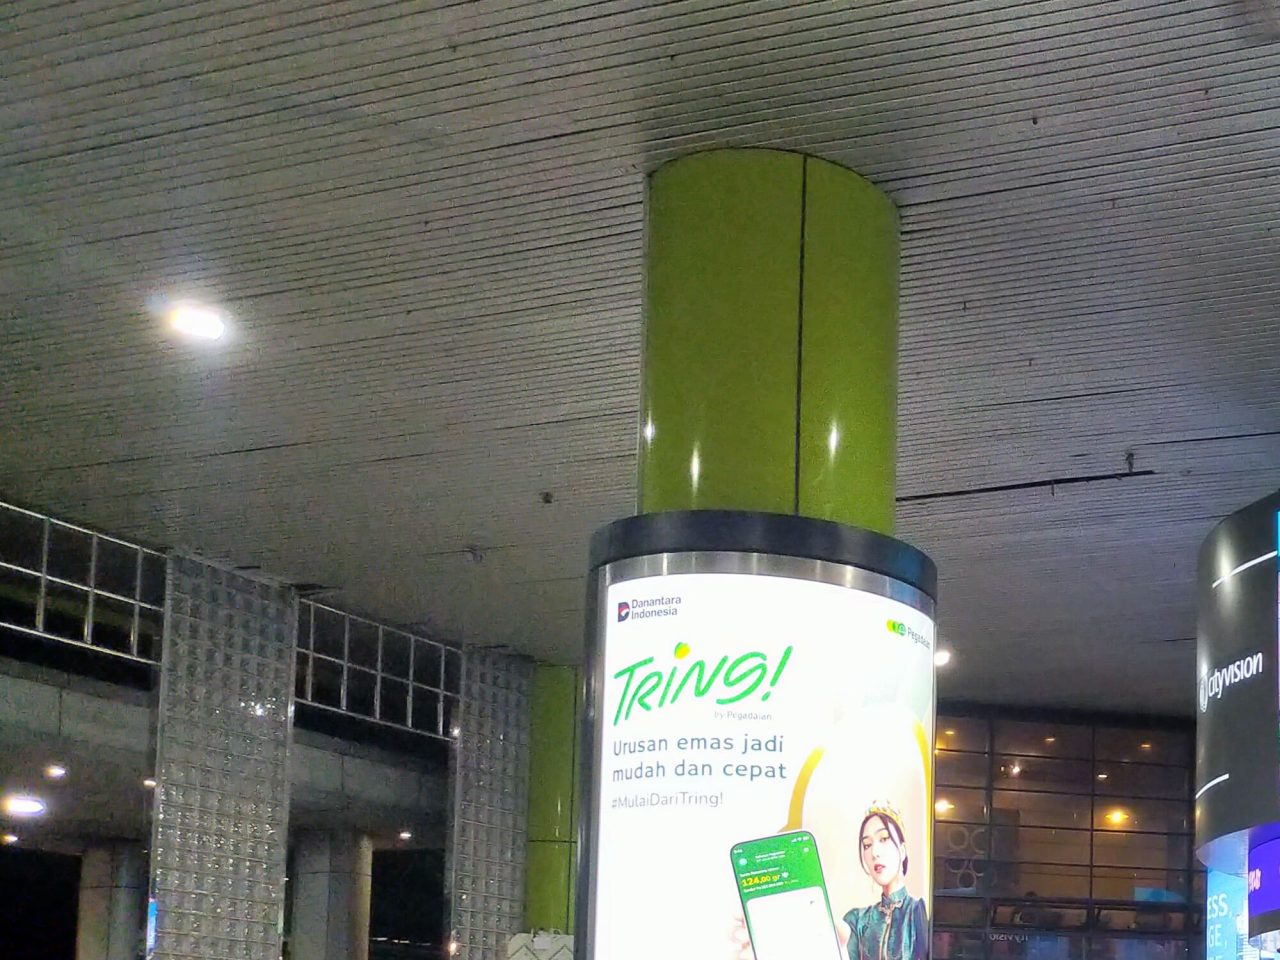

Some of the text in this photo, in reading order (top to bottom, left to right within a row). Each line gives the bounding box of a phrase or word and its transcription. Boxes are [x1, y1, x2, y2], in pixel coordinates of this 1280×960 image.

[631, 595, 682, 610] Danantara
[631, 606, 678, 620] Indonesia
[1208, 652, 1263, 699] cityvision
[726, 710, 772, 721] Pegadaian
[613, 733, 784, 757] Urusan emas jadi
[612, 758, 788, 782] mudah dan cepat
[611, 790, 724, 808] #MulaiDariTring!
